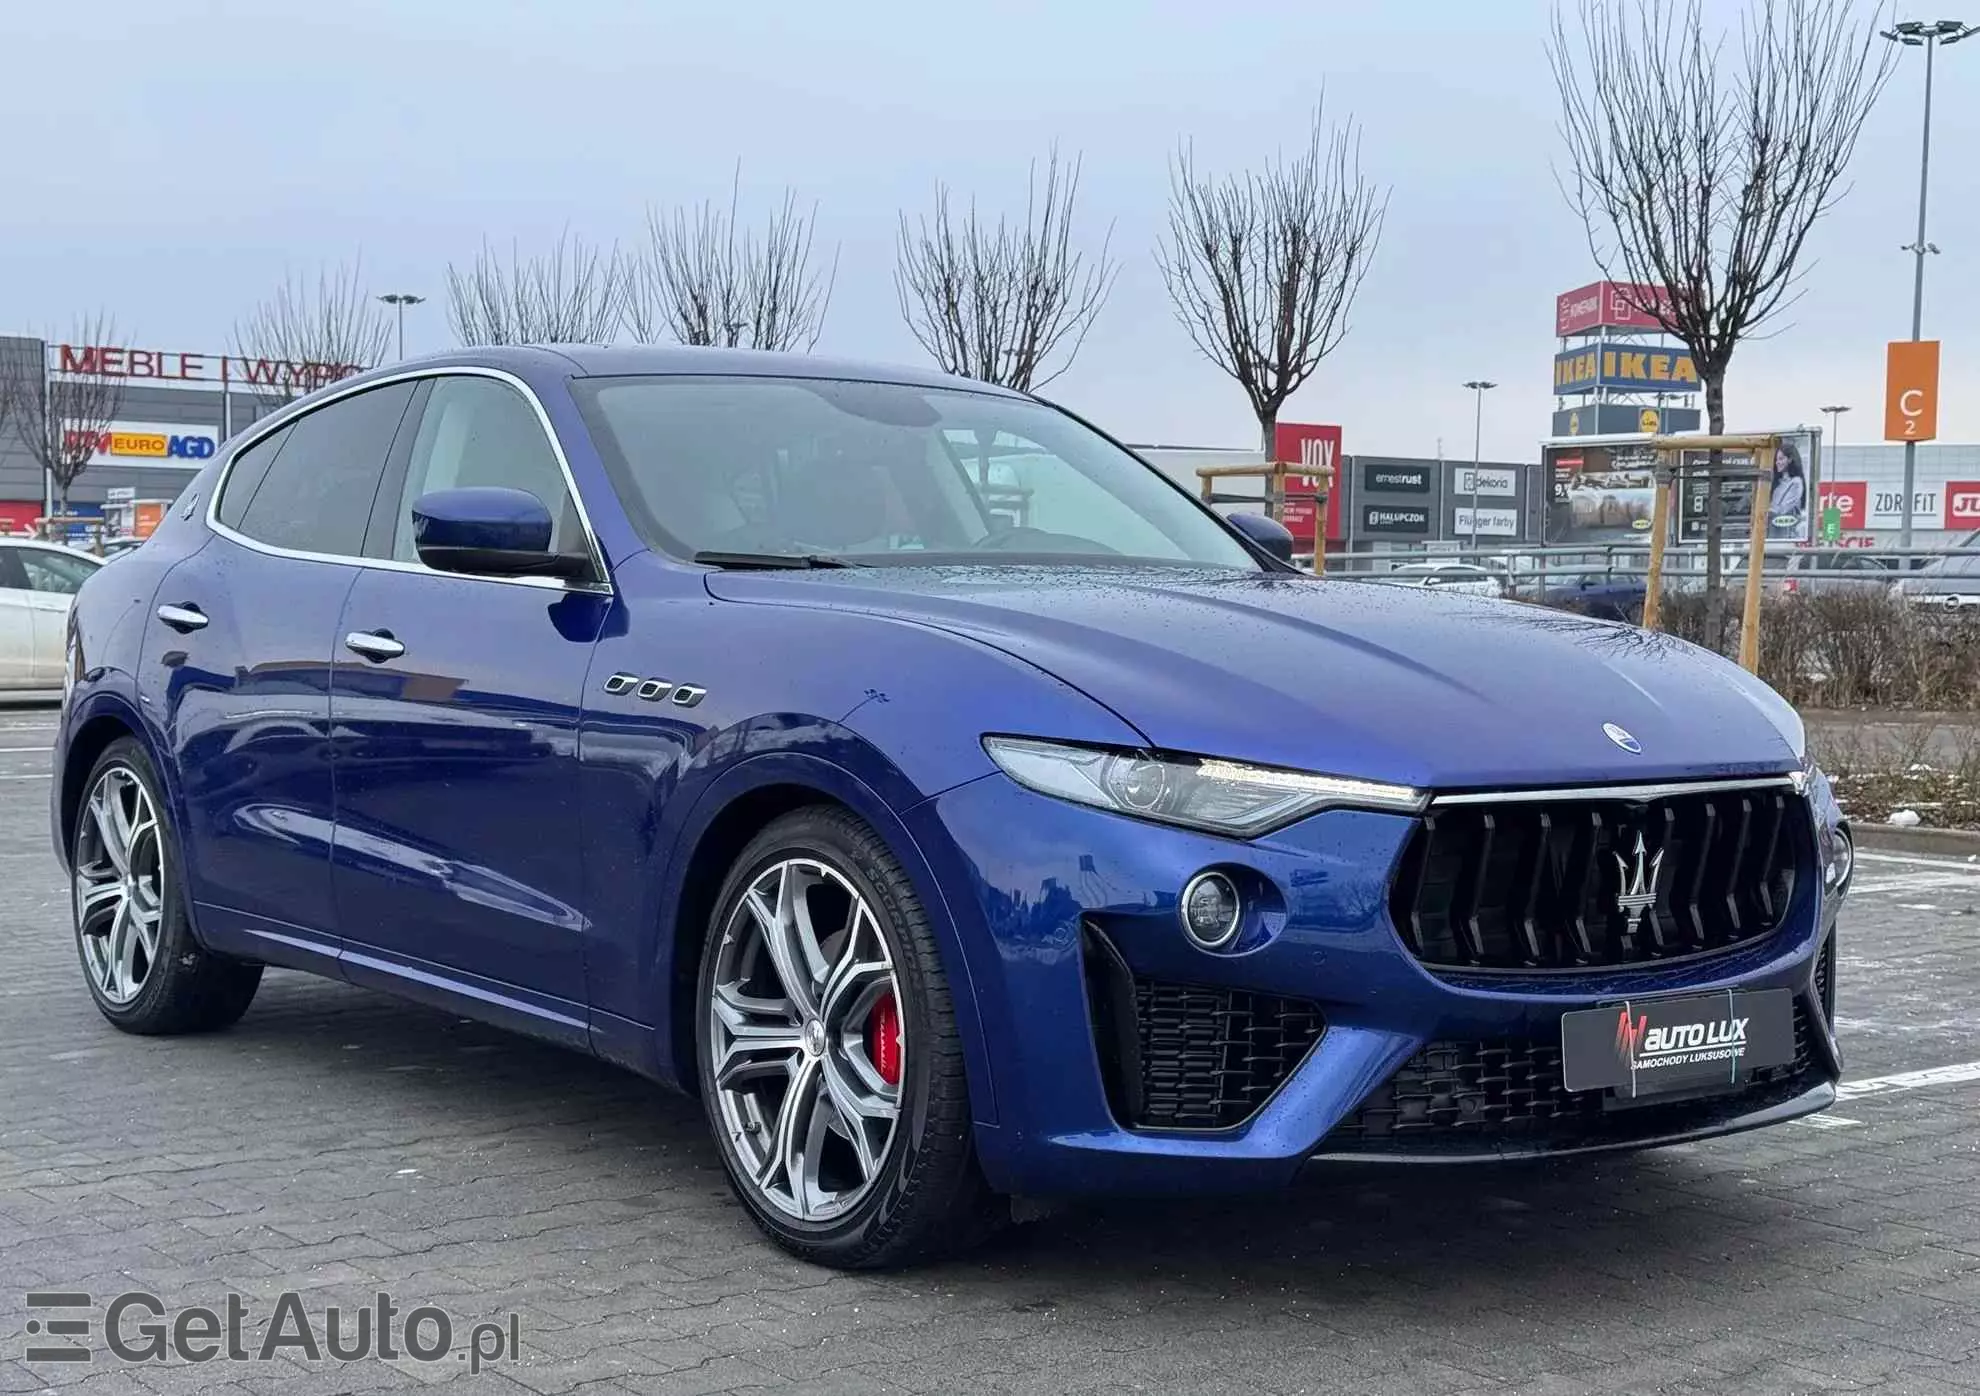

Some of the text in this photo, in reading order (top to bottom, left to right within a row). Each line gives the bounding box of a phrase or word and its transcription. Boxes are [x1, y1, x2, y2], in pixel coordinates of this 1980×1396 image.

[60, 344, 204, 381] MEBLE
[1555, 352, 1597, 386] IKEA
[1603, 351, 1697, 383] IKEA
[1900, 389, 1923, 416] C
[1904, 420, 1916, 435] 2
[113, 438, 165, 451] EURO
[167, 435, 215, 459] AGD
[1301, 438, 1335, 488] VOX
[1707, 1018, 1749, 1044] LUX
[1631, 1054, 1688, 1071] SAMOCHODY
